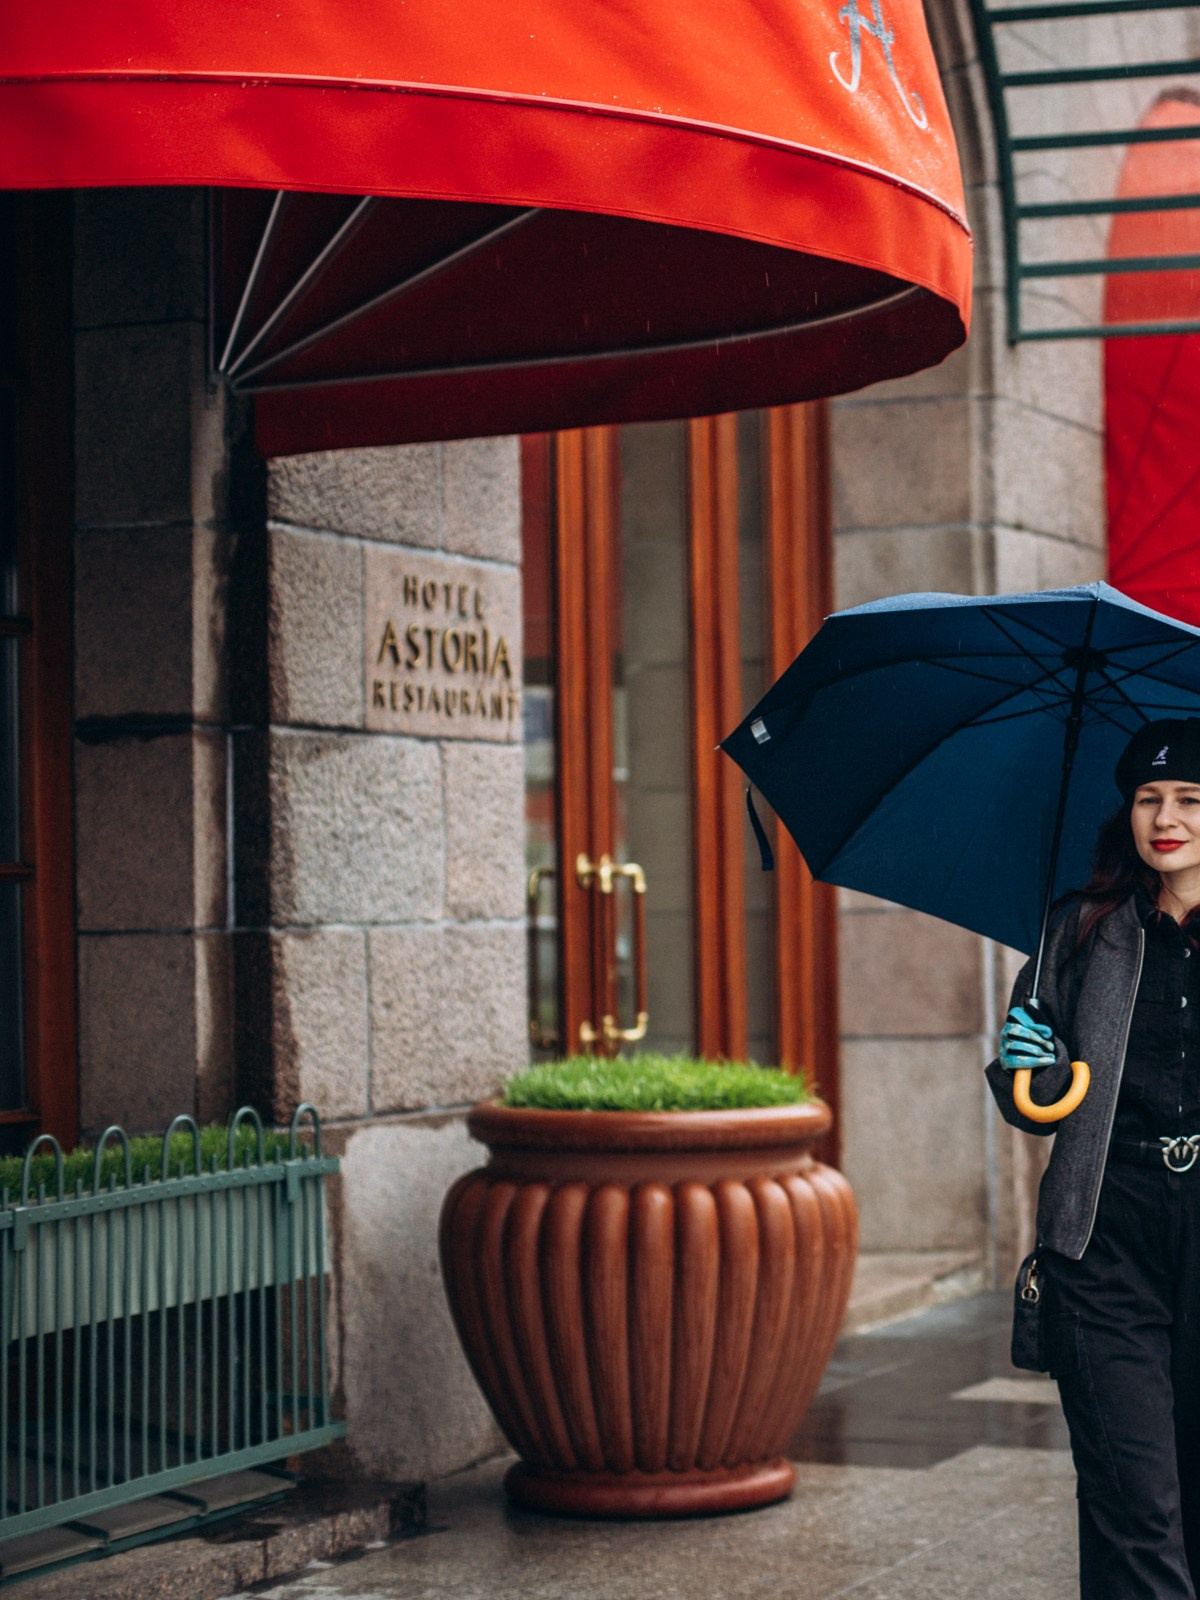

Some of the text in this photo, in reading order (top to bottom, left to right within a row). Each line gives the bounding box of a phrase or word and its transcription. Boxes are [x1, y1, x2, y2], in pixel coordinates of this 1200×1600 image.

[403, 575, 484, 620] HOTEL
[376, 619, 512, 680] ASTORIA
[372, 679, 517, 721] RESTAURANT
